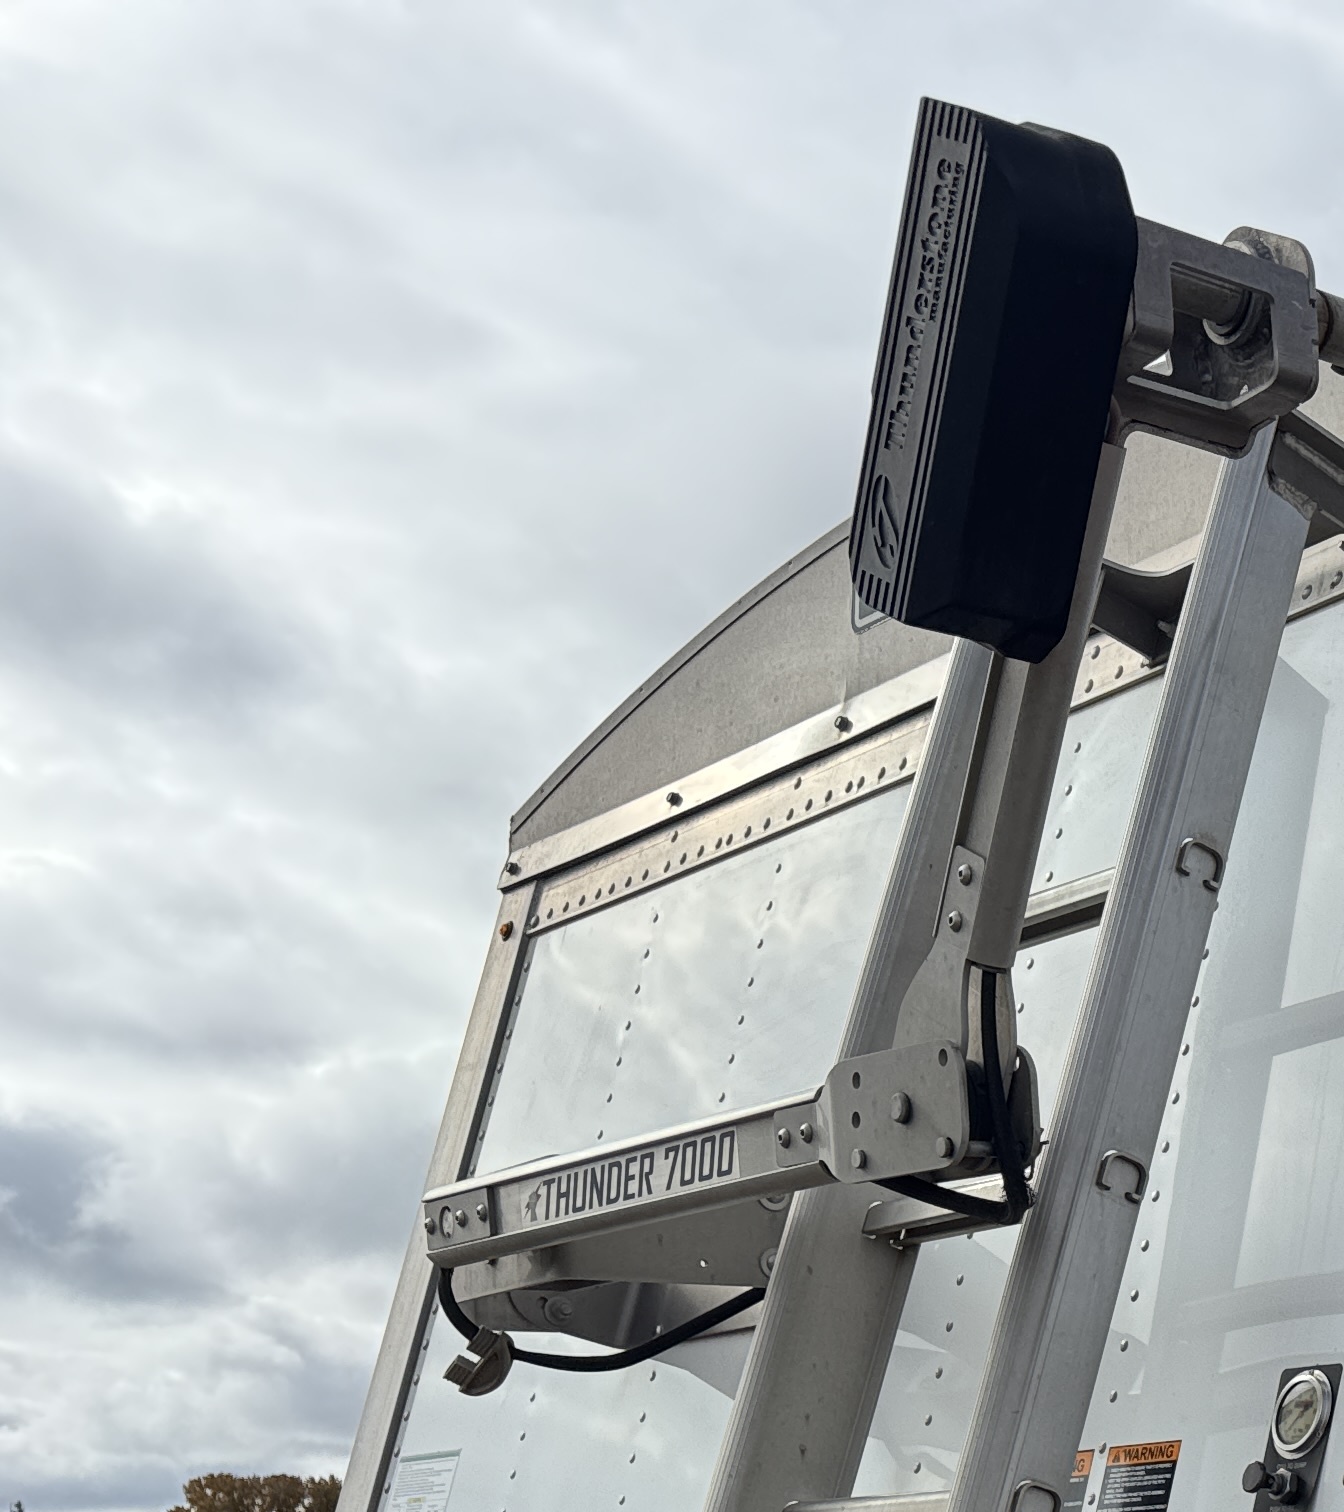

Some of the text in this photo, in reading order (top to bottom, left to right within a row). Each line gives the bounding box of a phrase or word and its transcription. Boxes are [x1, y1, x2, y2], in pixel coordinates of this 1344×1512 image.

[884, 158, 953, 451] Thunderstone
[541, 1130, 736, 1222] THUNDER 7000
[1122, 1444, 1175, 1462] WARNING
